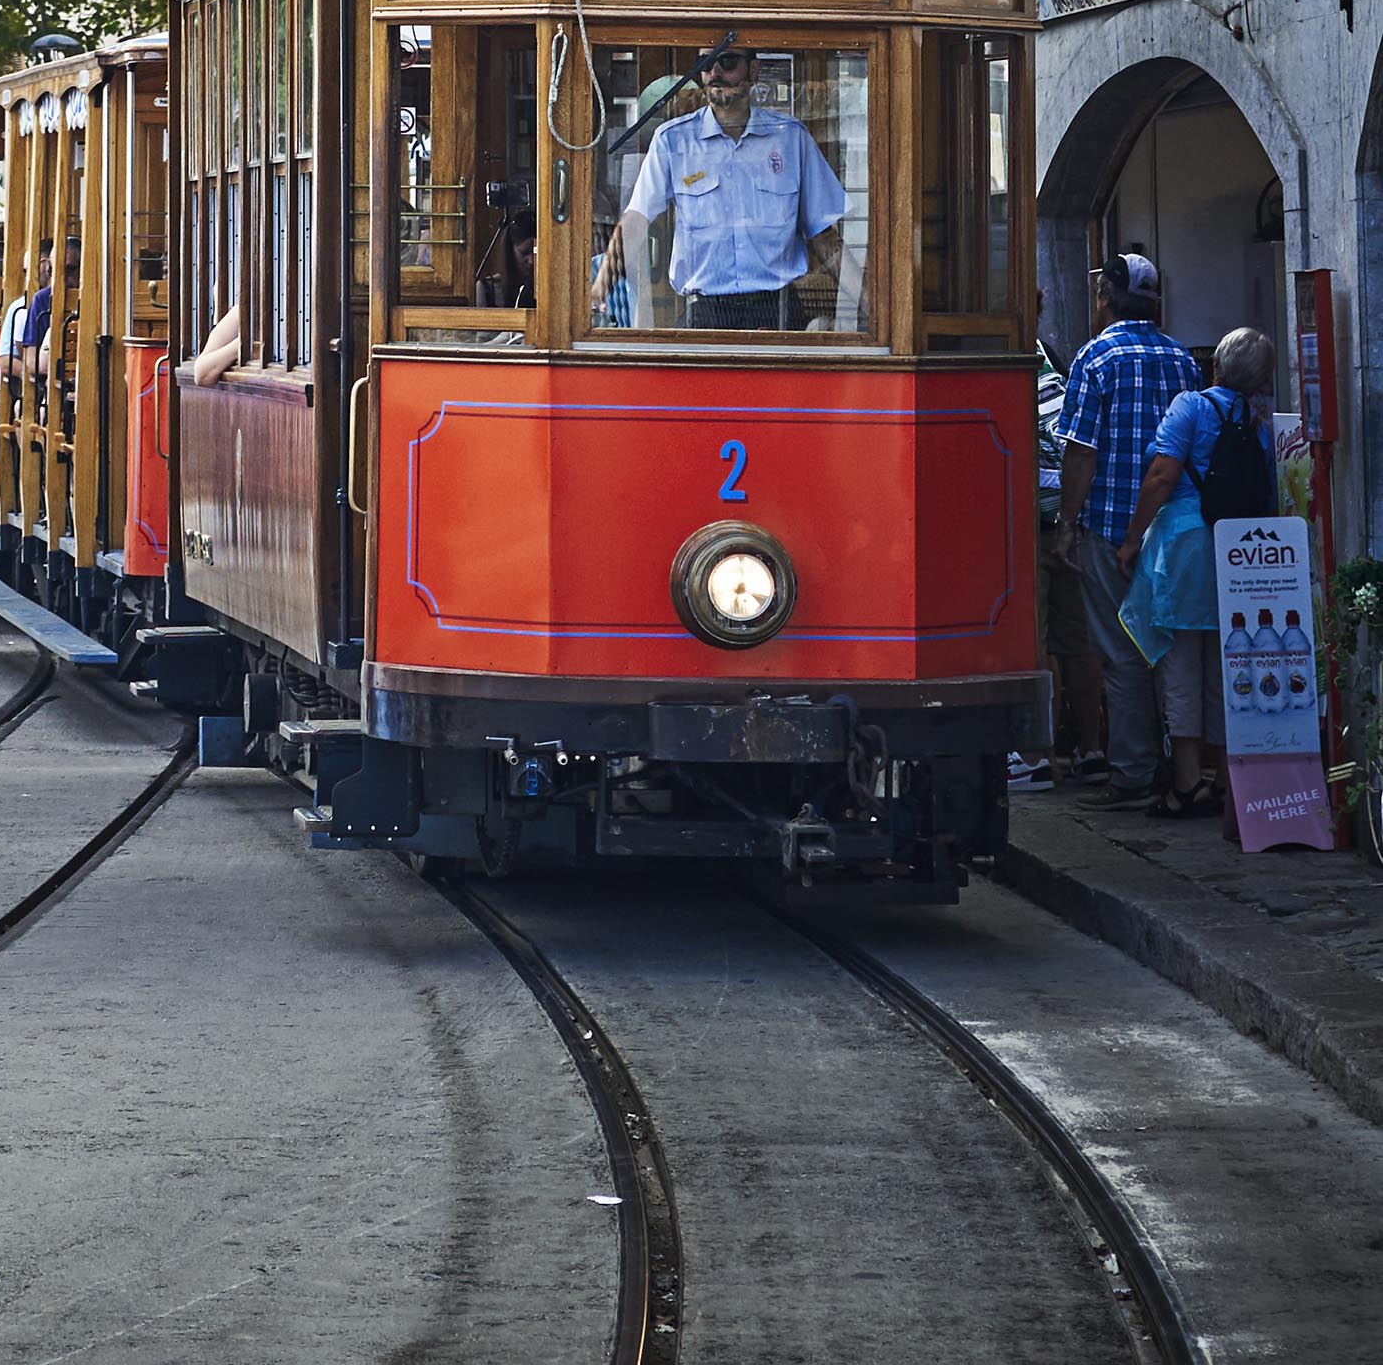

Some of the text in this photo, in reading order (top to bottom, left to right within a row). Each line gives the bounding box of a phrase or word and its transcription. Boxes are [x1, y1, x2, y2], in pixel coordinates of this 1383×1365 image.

[719, 440, 747, 500] 2
[1228, 543, 1295, 566] evian
[1257, 658, 1281, 667] evian
[1246, 789, 1321, 813] AVAILABLE
[1268, 805, 1306, 821] HERE
